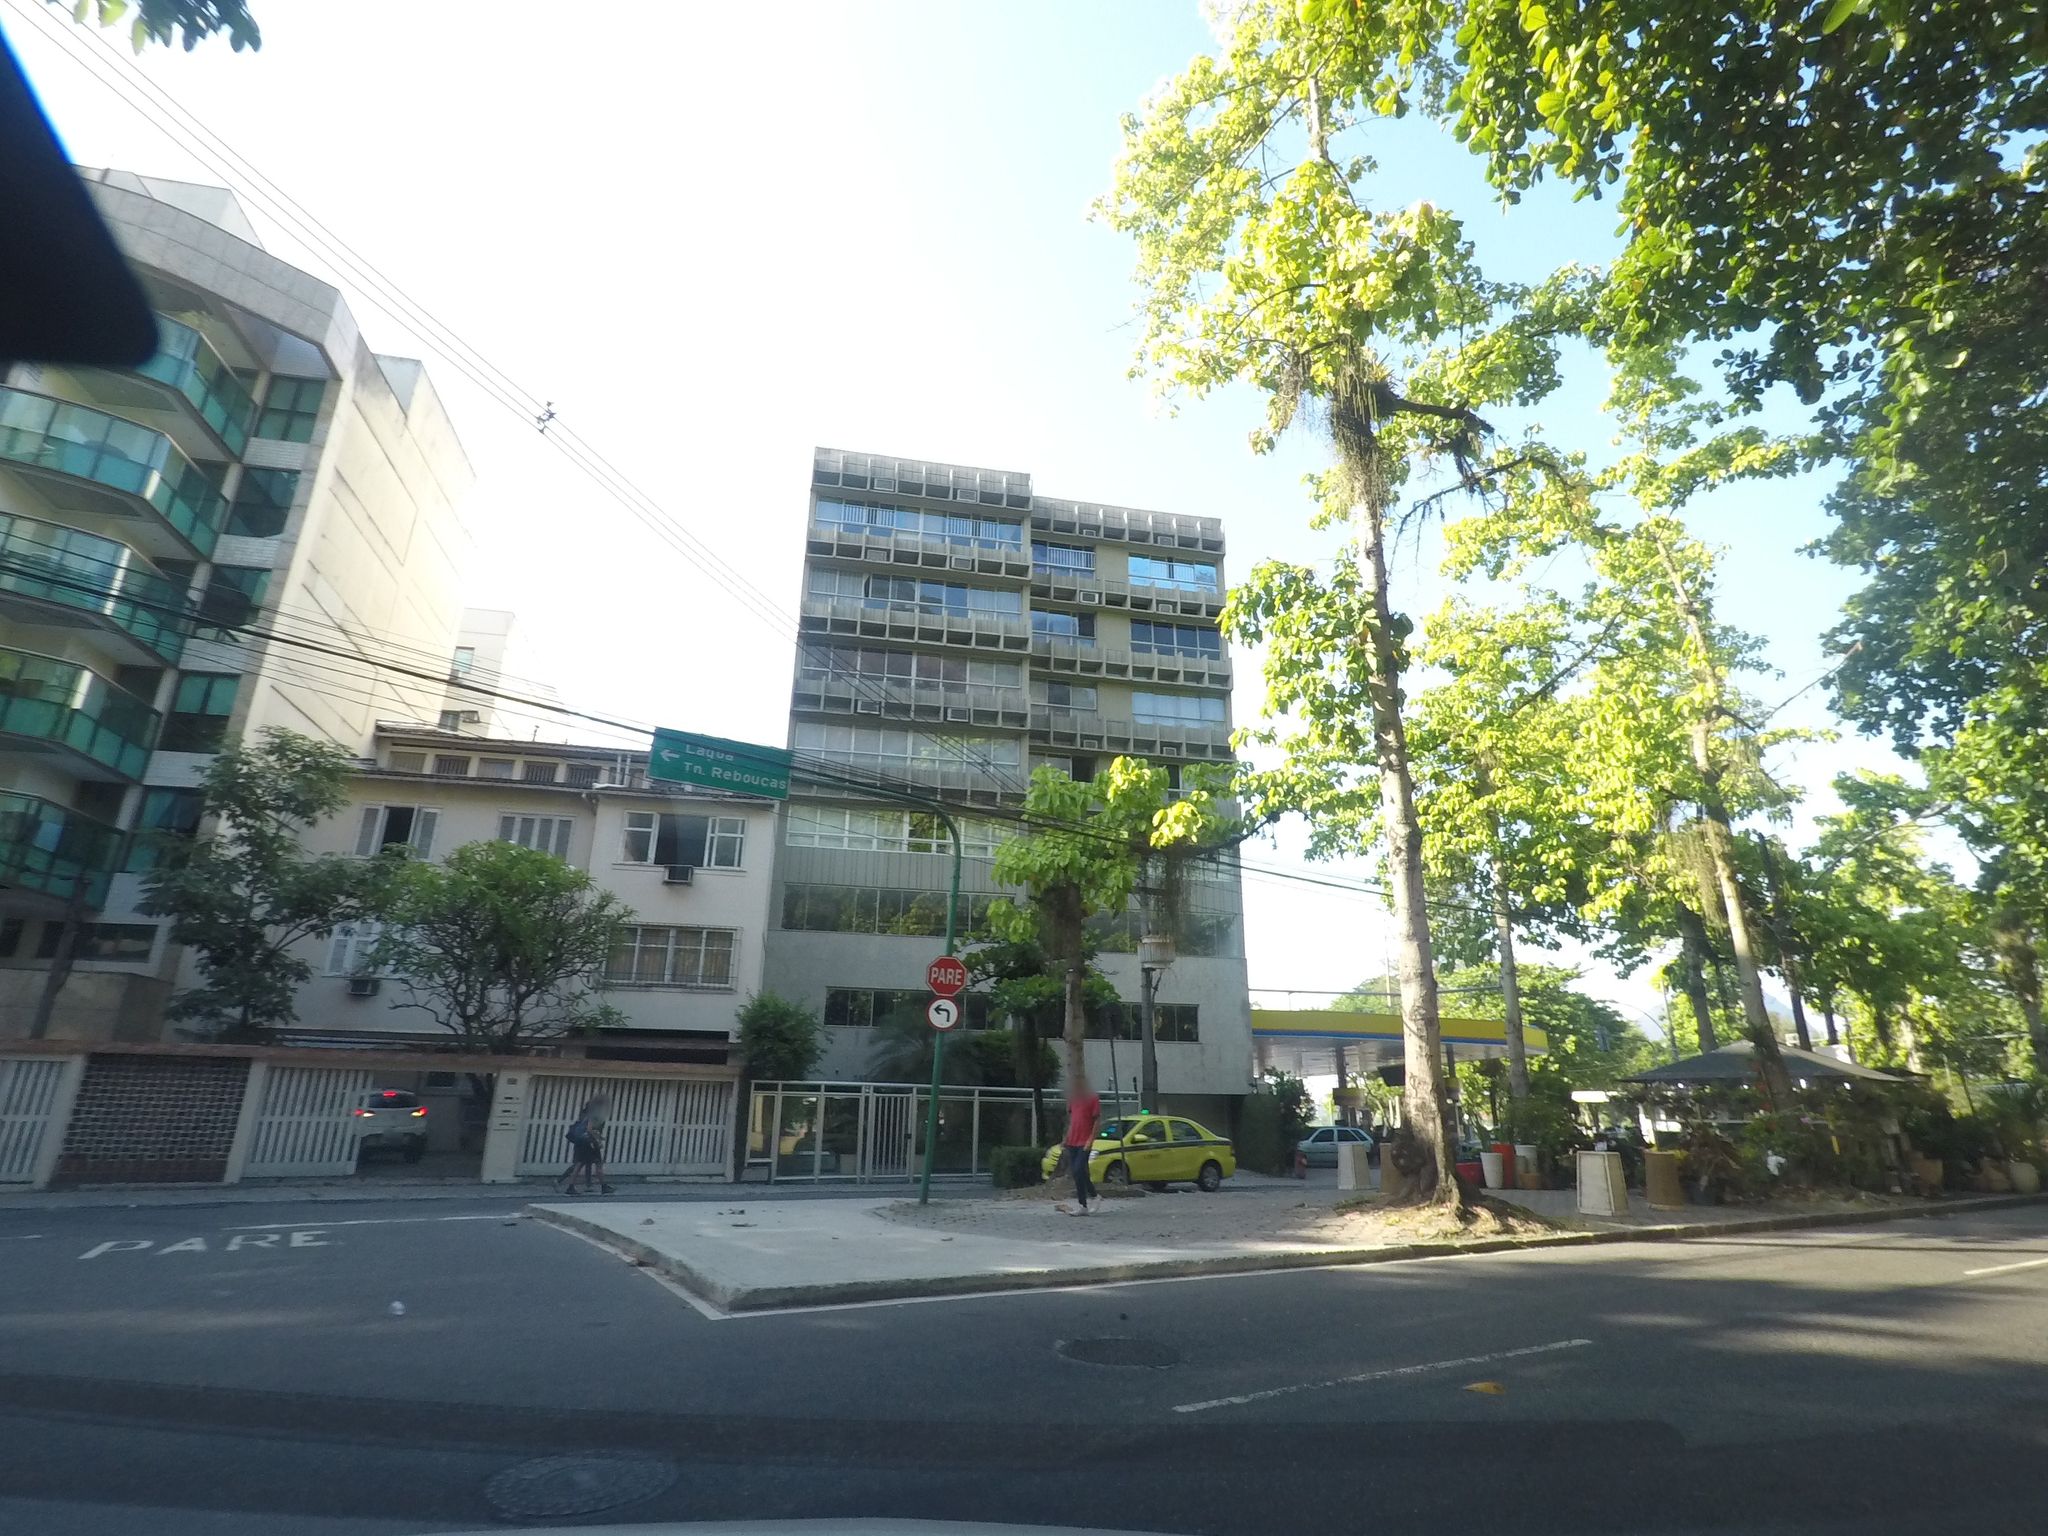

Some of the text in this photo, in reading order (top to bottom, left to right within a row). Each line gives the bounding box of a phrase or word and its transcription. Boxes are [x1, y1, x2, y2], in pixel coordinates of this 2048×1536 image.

[684, 762, 705, 775] Tn.
[930, 967, 963, 986] PARE
[77, 1230, 332, 1260] PARE
